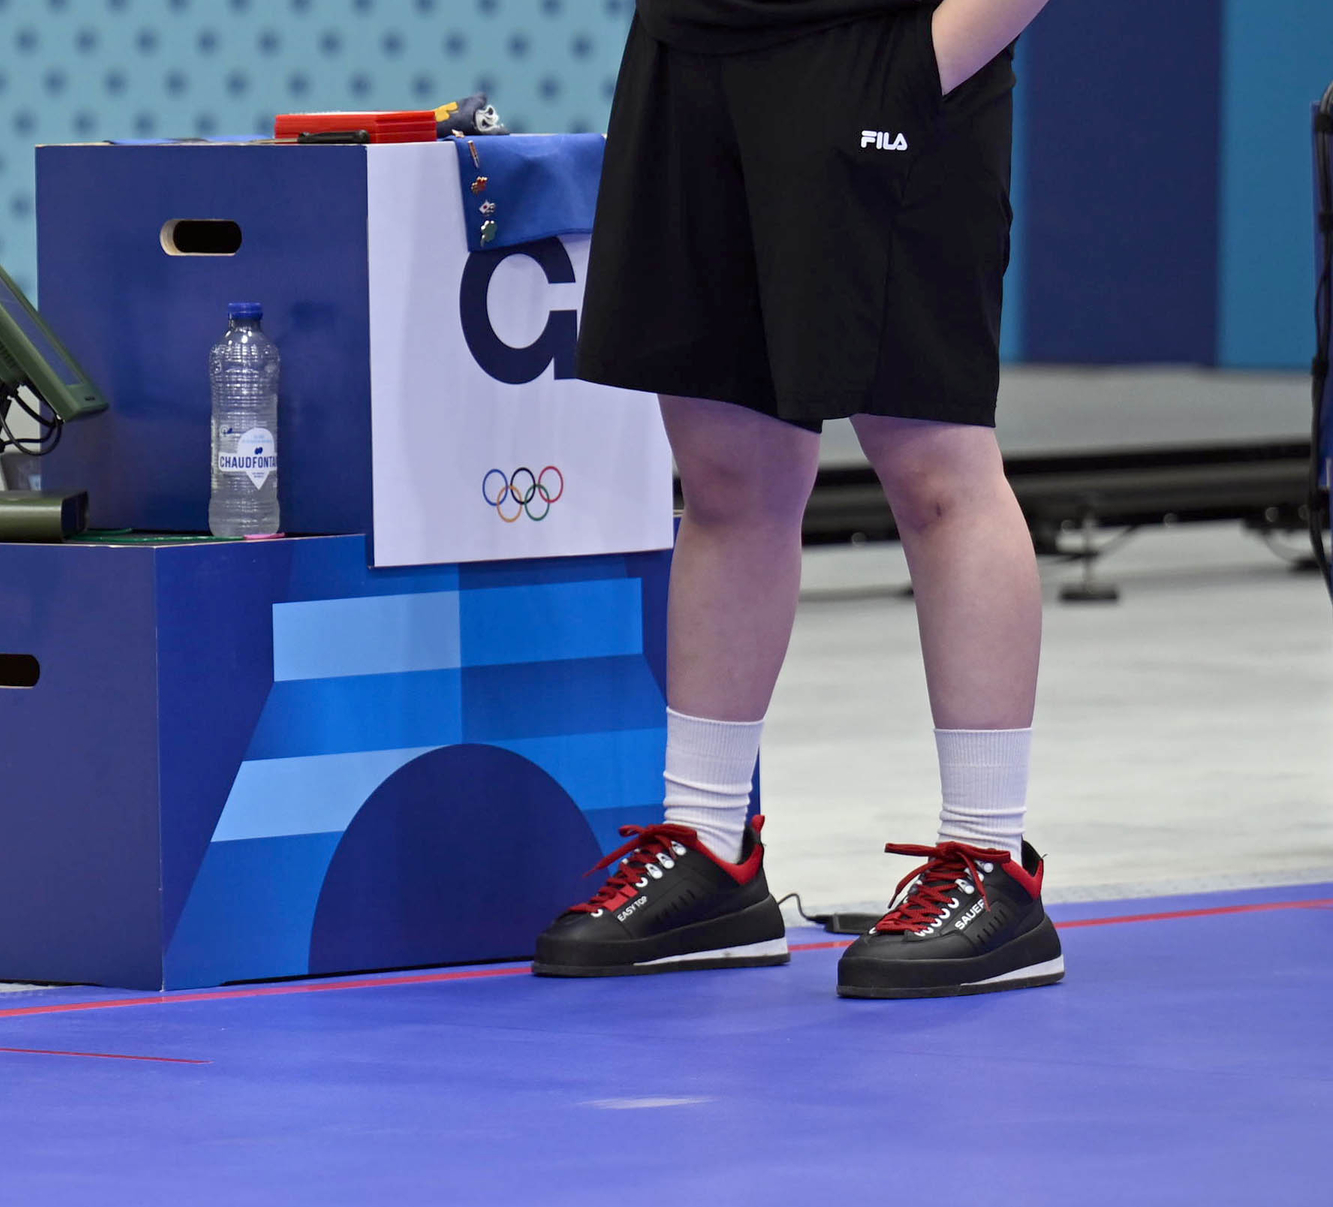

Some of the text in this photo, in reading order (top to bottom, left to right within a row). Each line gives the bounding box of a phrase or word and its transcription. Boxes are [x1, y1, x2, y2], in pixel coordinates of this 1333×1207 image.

[861, 130, 907, 151] FILA
[617, 896, 648, 922] EASY TOP
